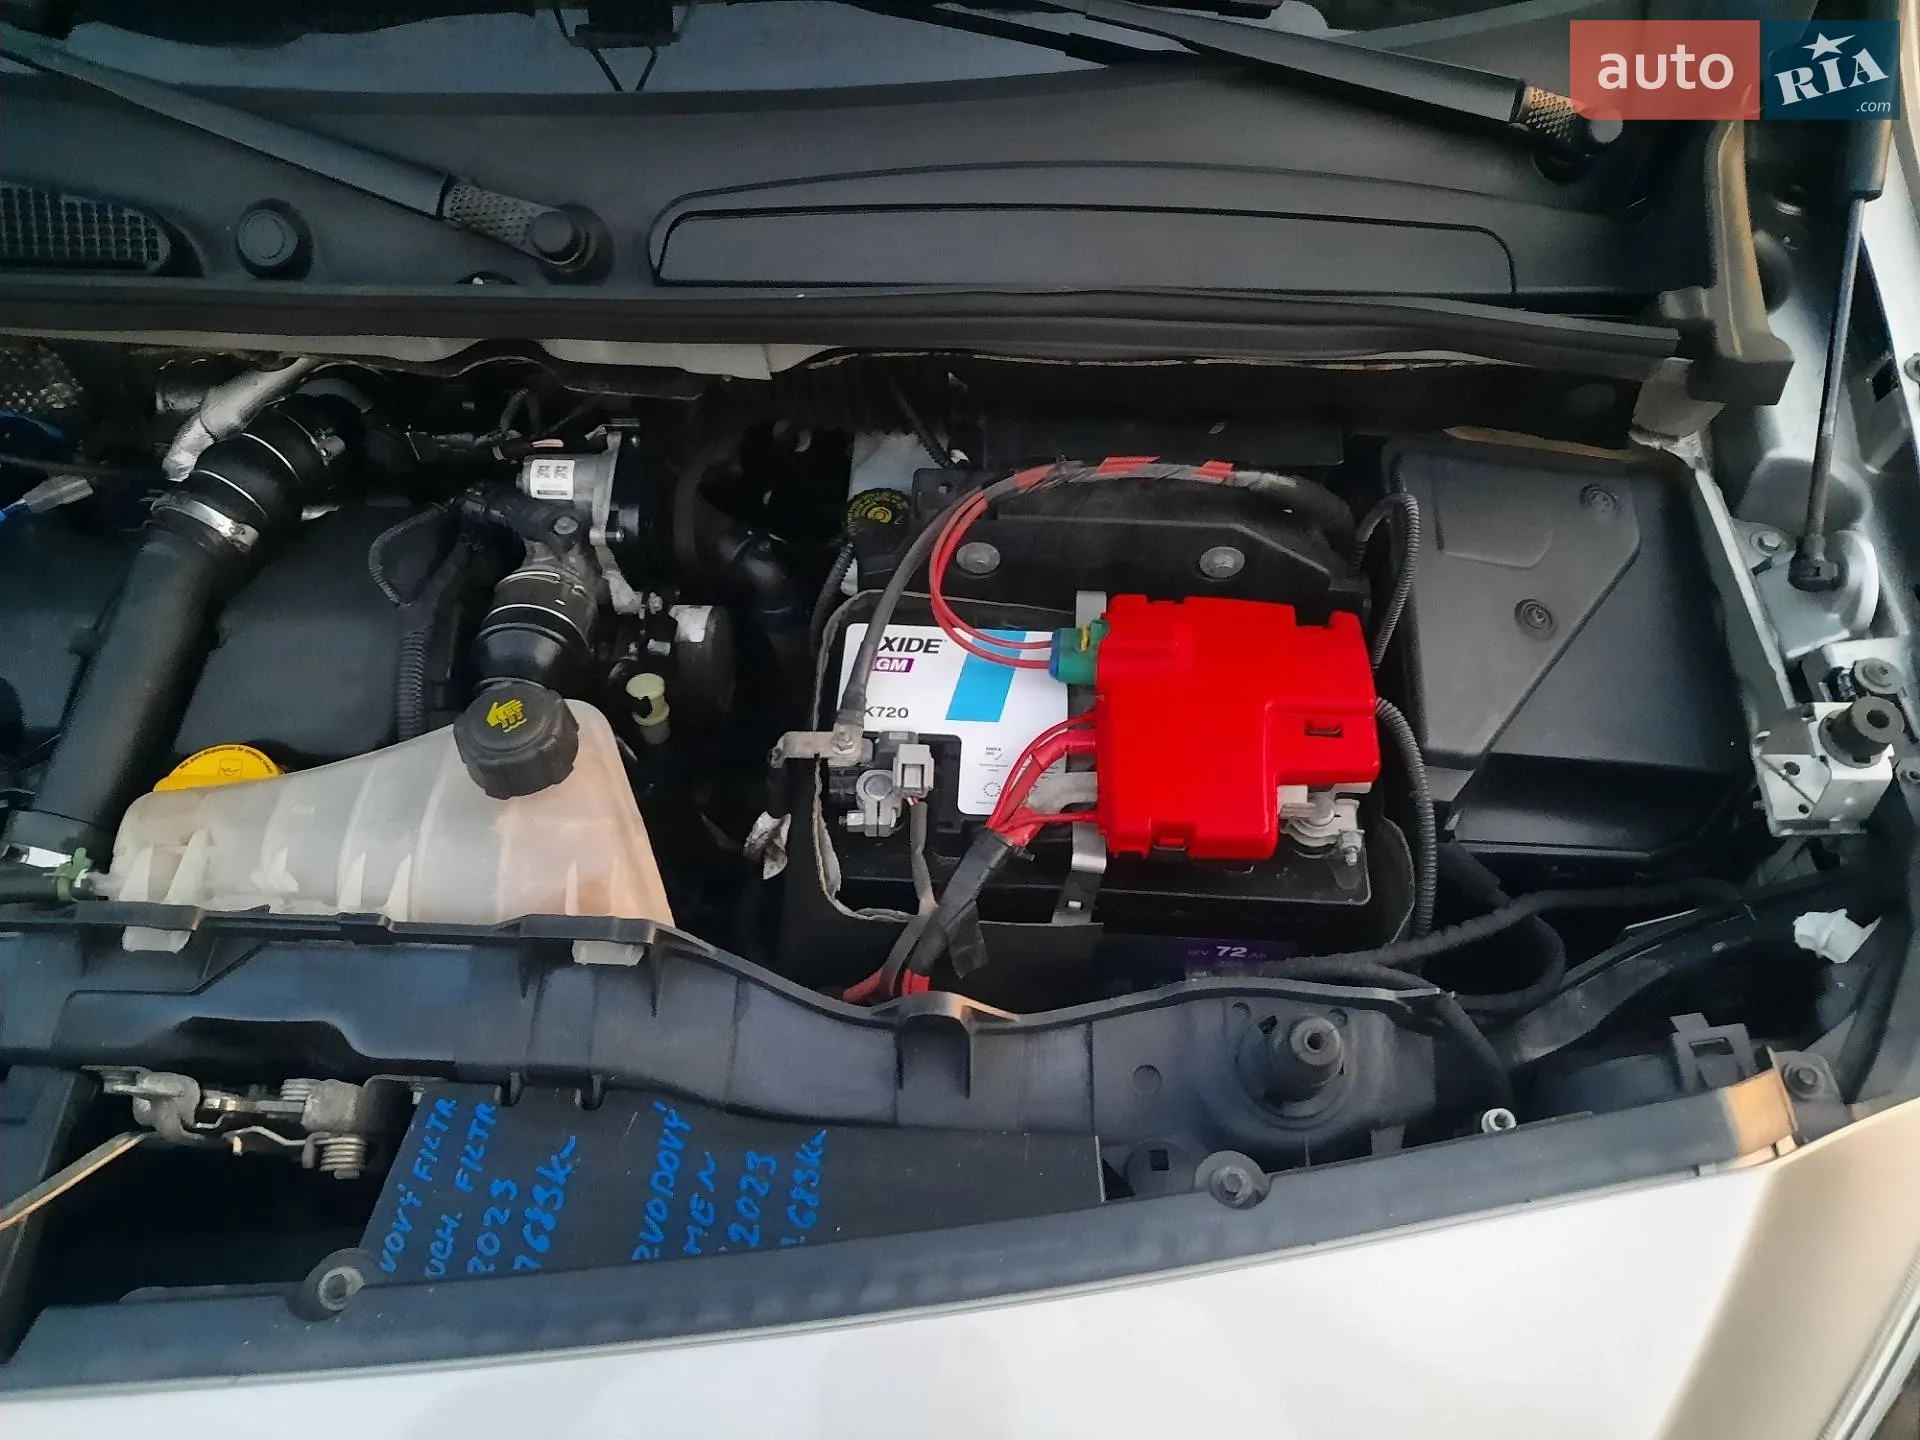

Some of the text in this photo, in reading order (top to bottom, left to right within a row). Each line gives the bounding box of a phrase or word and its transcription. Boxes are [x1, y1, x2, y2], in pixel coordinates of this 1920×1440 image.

[878, 636, 943, 654] XIDE
[873, 657, 909, 671] GM
[865, 706, 909, 718] K720
[1215, 945, 1248, 958] 72
